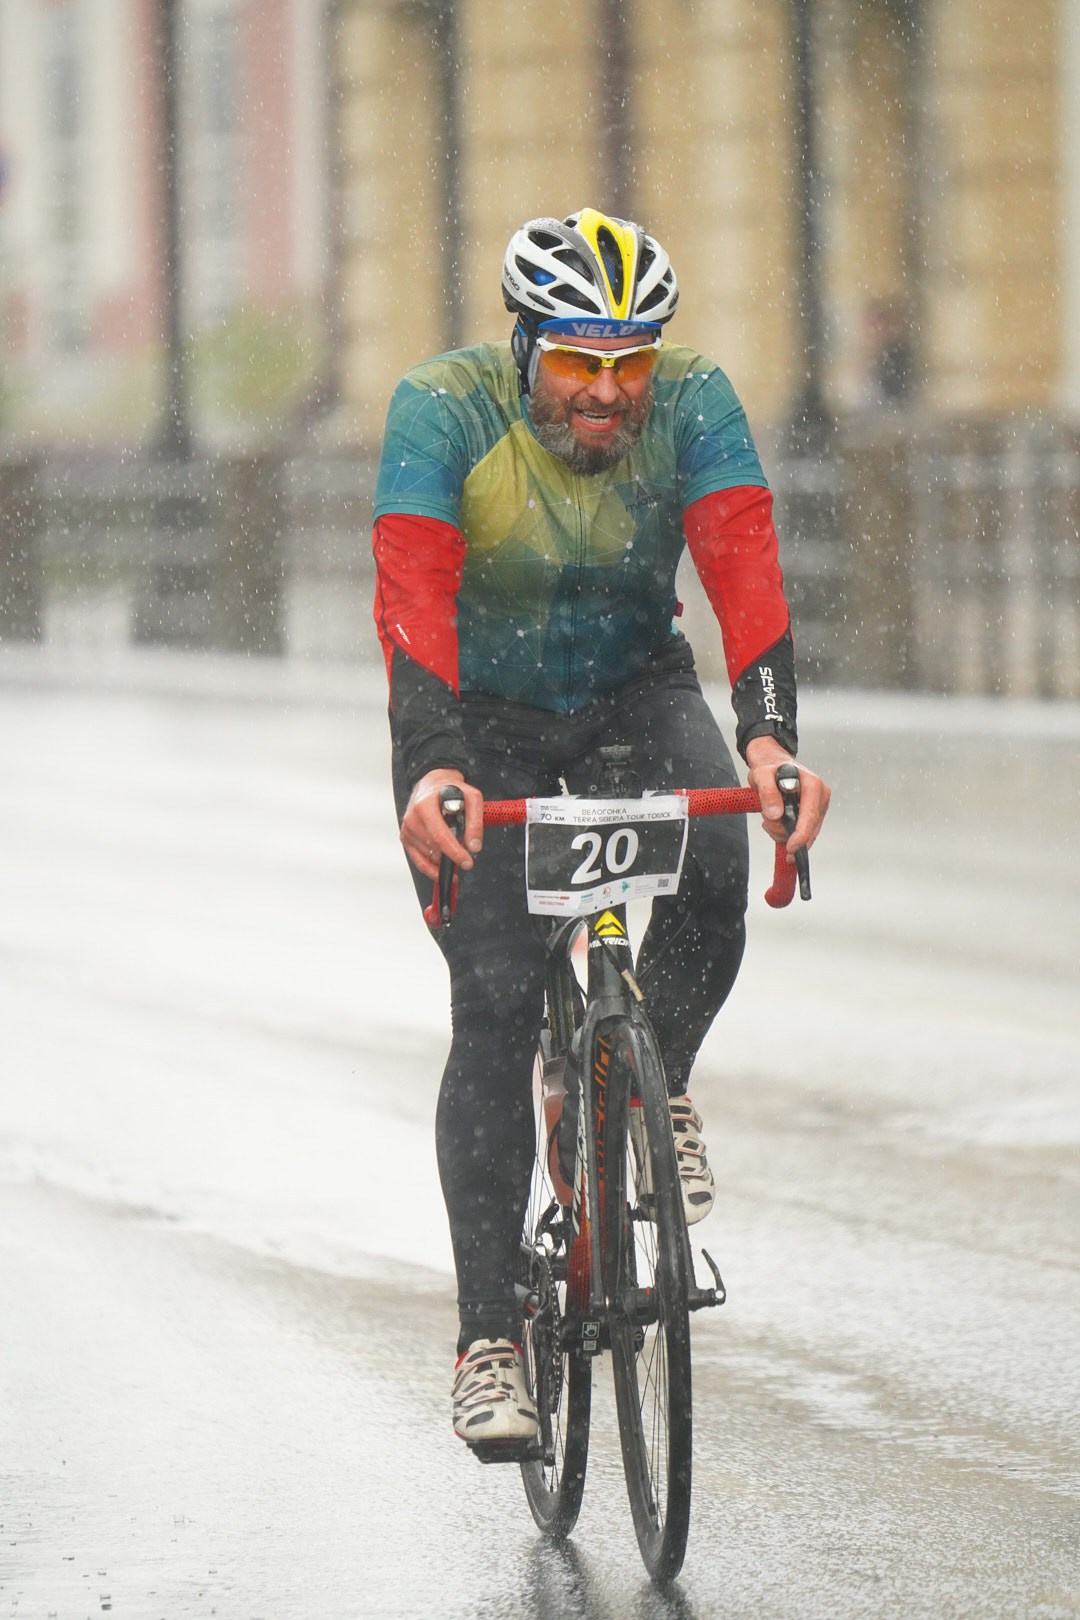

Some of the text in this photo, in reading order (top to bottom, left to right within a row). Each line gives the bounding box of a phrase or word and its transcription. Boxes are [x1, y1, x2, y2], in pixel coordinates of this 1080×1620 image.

[581, 808, 627, 816] ВЕЛОГОНКА
[540, 813, 552, 821] 70
[598, 814, 624, 823] SIBERIA
[570, 828, 639, 884] 20
